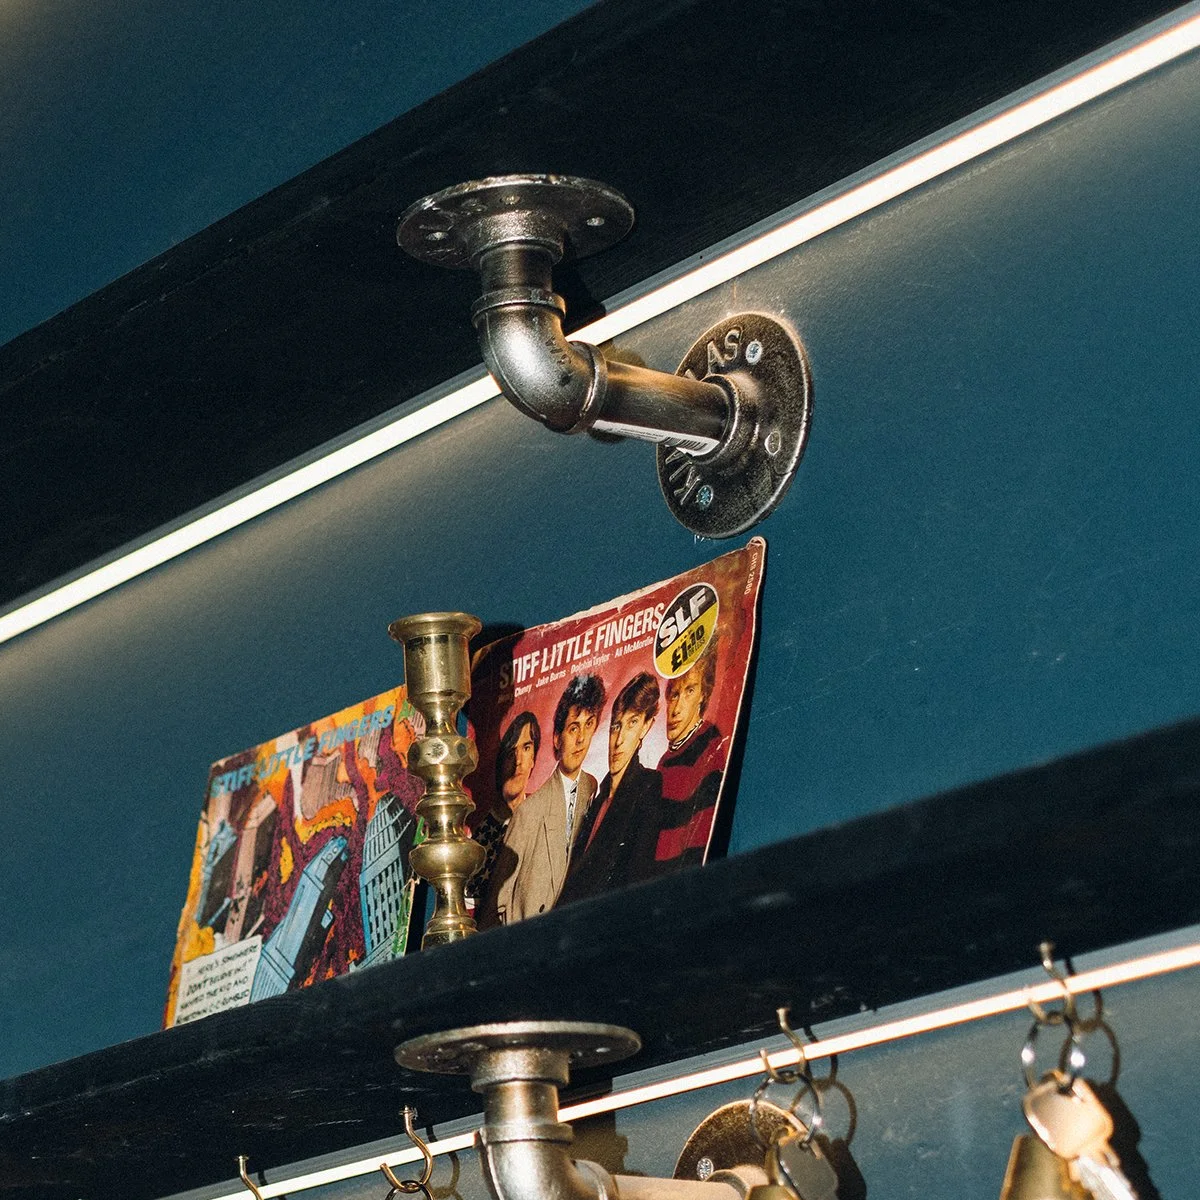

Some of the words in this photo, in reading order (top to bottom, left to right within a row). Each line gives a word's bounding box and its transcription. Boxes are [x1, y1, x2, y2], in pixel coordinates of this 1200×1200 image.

[500, 650, 540, 689] STIFF
[540, 629, 594, 674] LITTLE
[595, 602, 665, 652] FINGERS
[659, 587, 706, 648] SLF
[210, 763, 256, 798] STIFF
[257, 736, 318, 781] LITTLE
[317, 705, 395, 752] FINGERS
